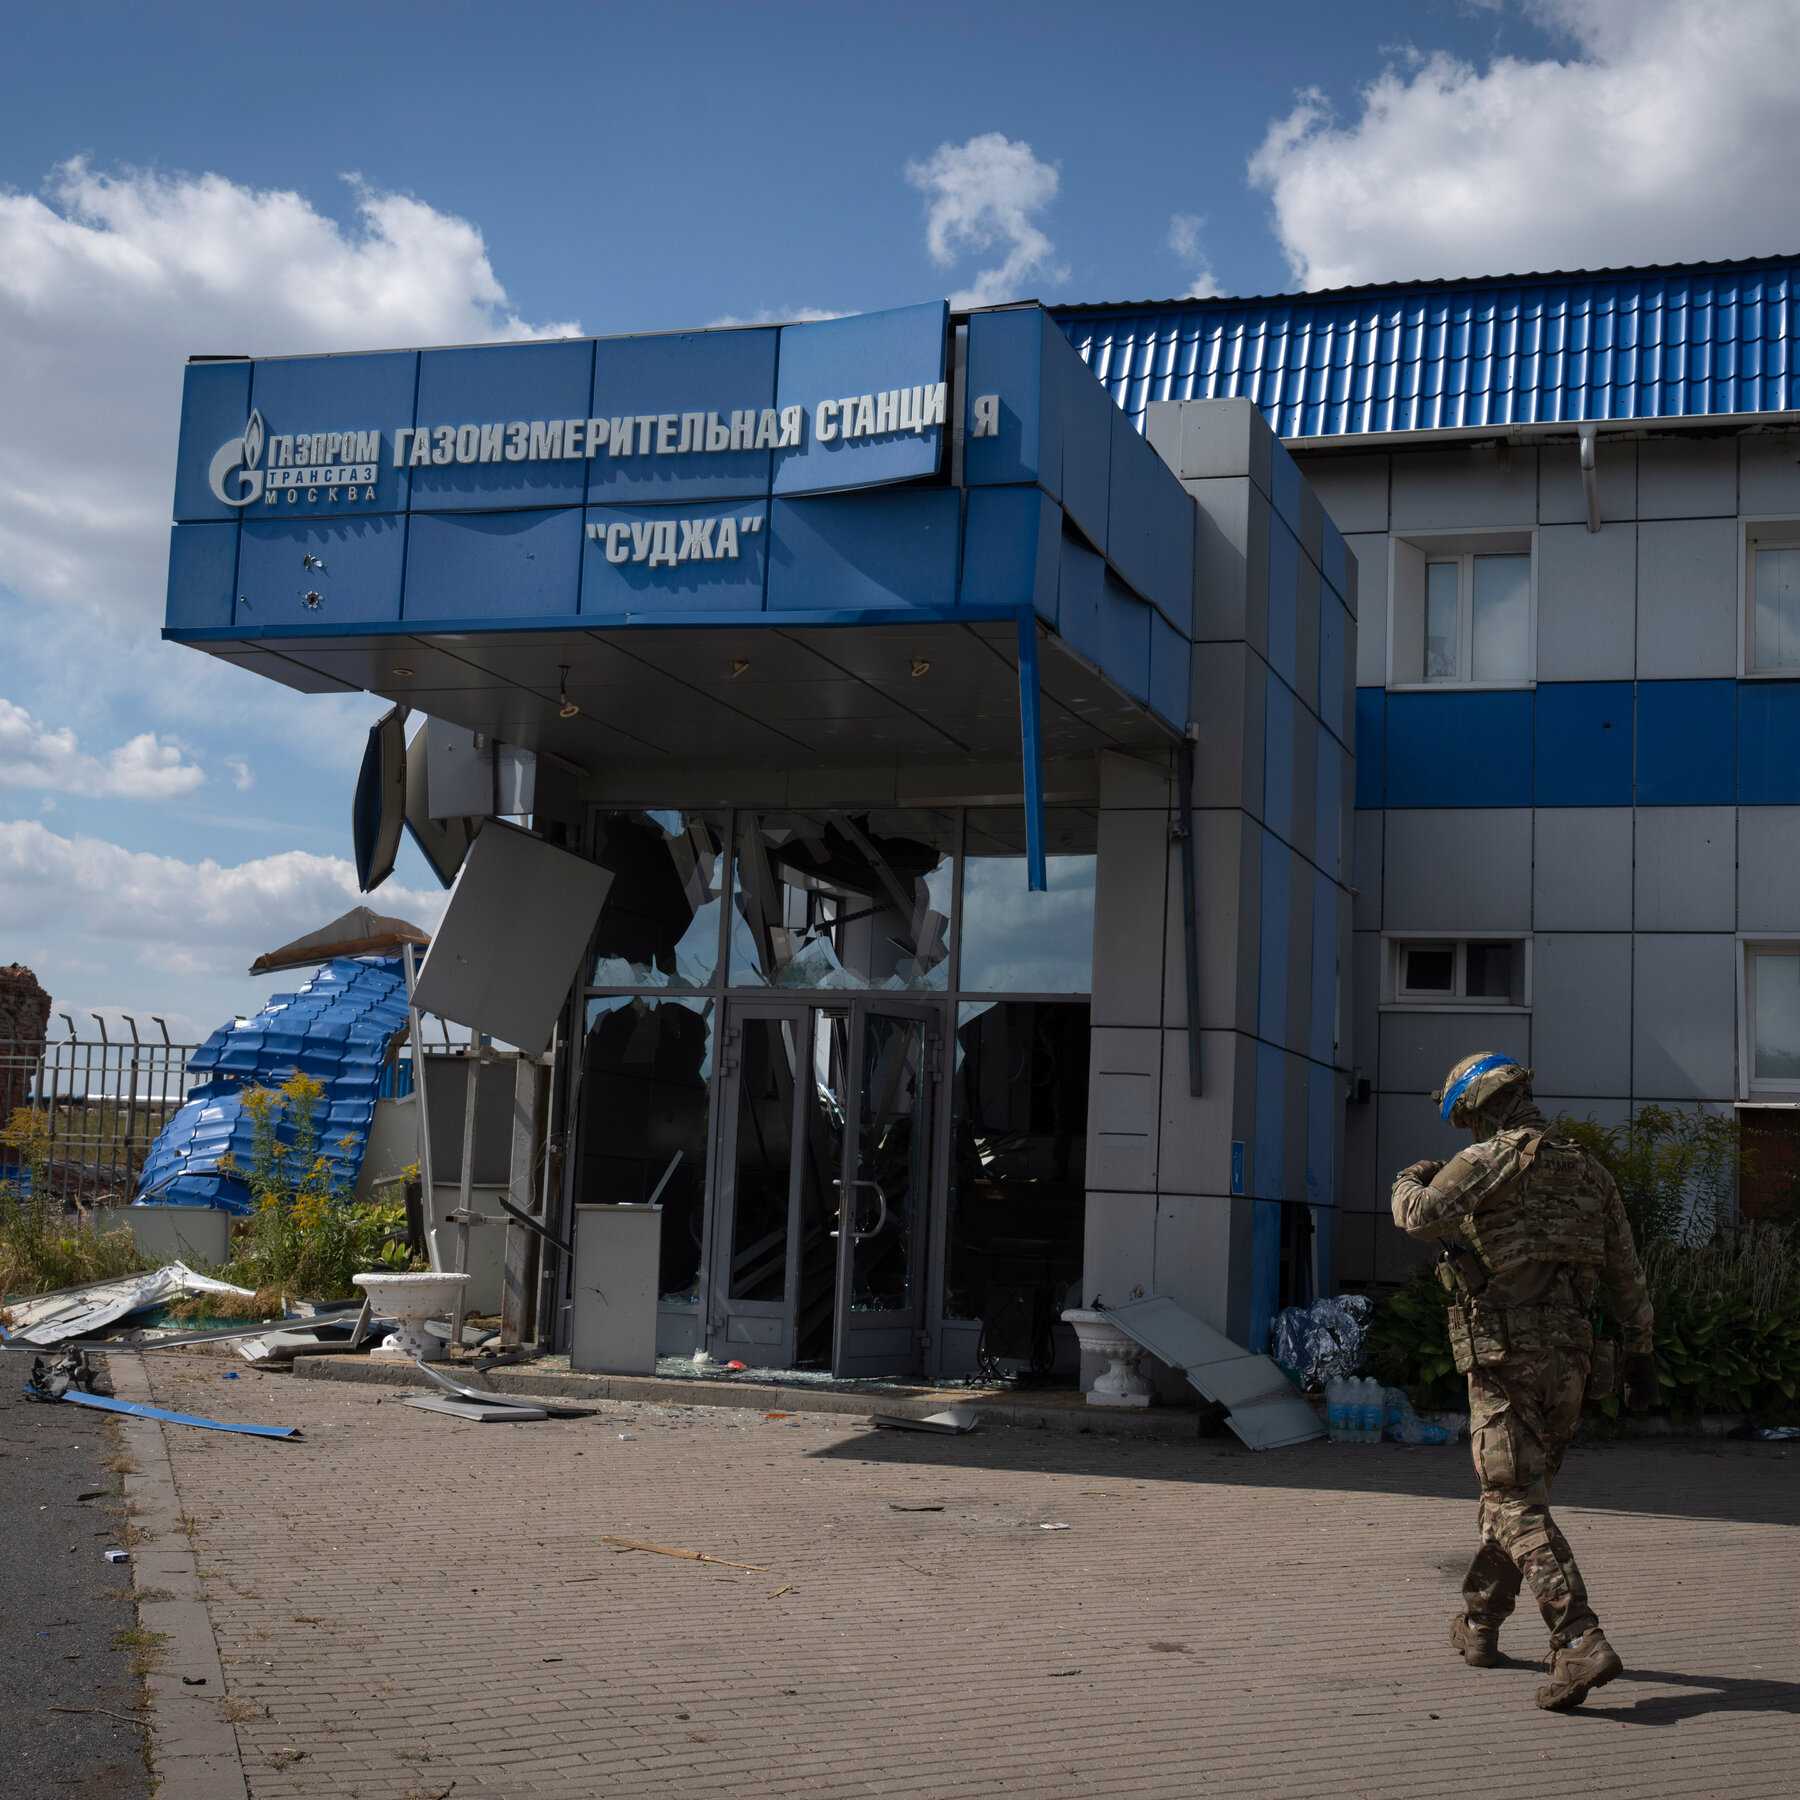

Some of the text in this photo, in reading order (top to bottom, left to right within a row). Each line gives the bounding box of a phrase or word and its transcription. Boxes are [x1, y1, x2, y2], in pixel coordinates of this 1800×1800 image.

[267, 430, 381, 467] ГАЗПРОМ
[393, 404, 802, 468] ГАЗОИЗМЕРИТЕЛЬНАЯ
[269, 467, 372, 485] ТРАНСГАЗ
[264, 485, 376, 505] МОСКВА
[586, 516, 763, 567] "СУДЖА"
